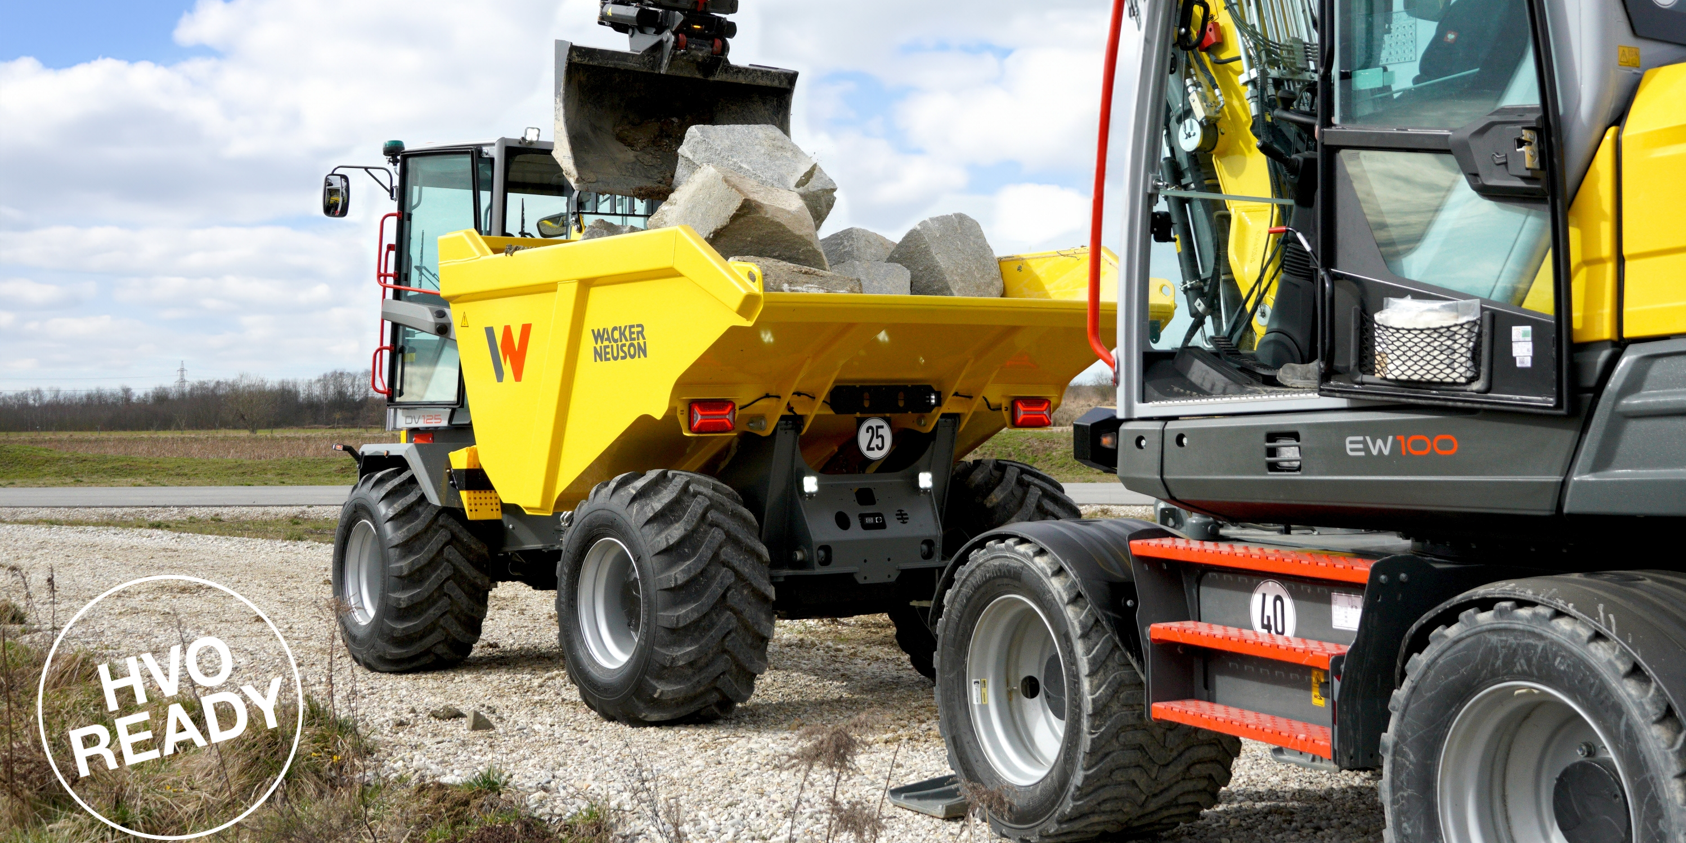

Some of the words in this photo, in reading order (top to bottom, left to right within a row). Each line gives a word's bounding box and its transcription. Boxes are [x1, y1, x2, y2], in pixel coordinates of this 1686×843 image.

[591, 323, 646, 345] WACKER
[593, 340, 648, 363] NEUSON
[404, 414, 443, 425] DV125
[865, 426, 885, 452] 25
[1345, 434, 1459, 456] EW100
[1261, 592, 1285, 636] 40
